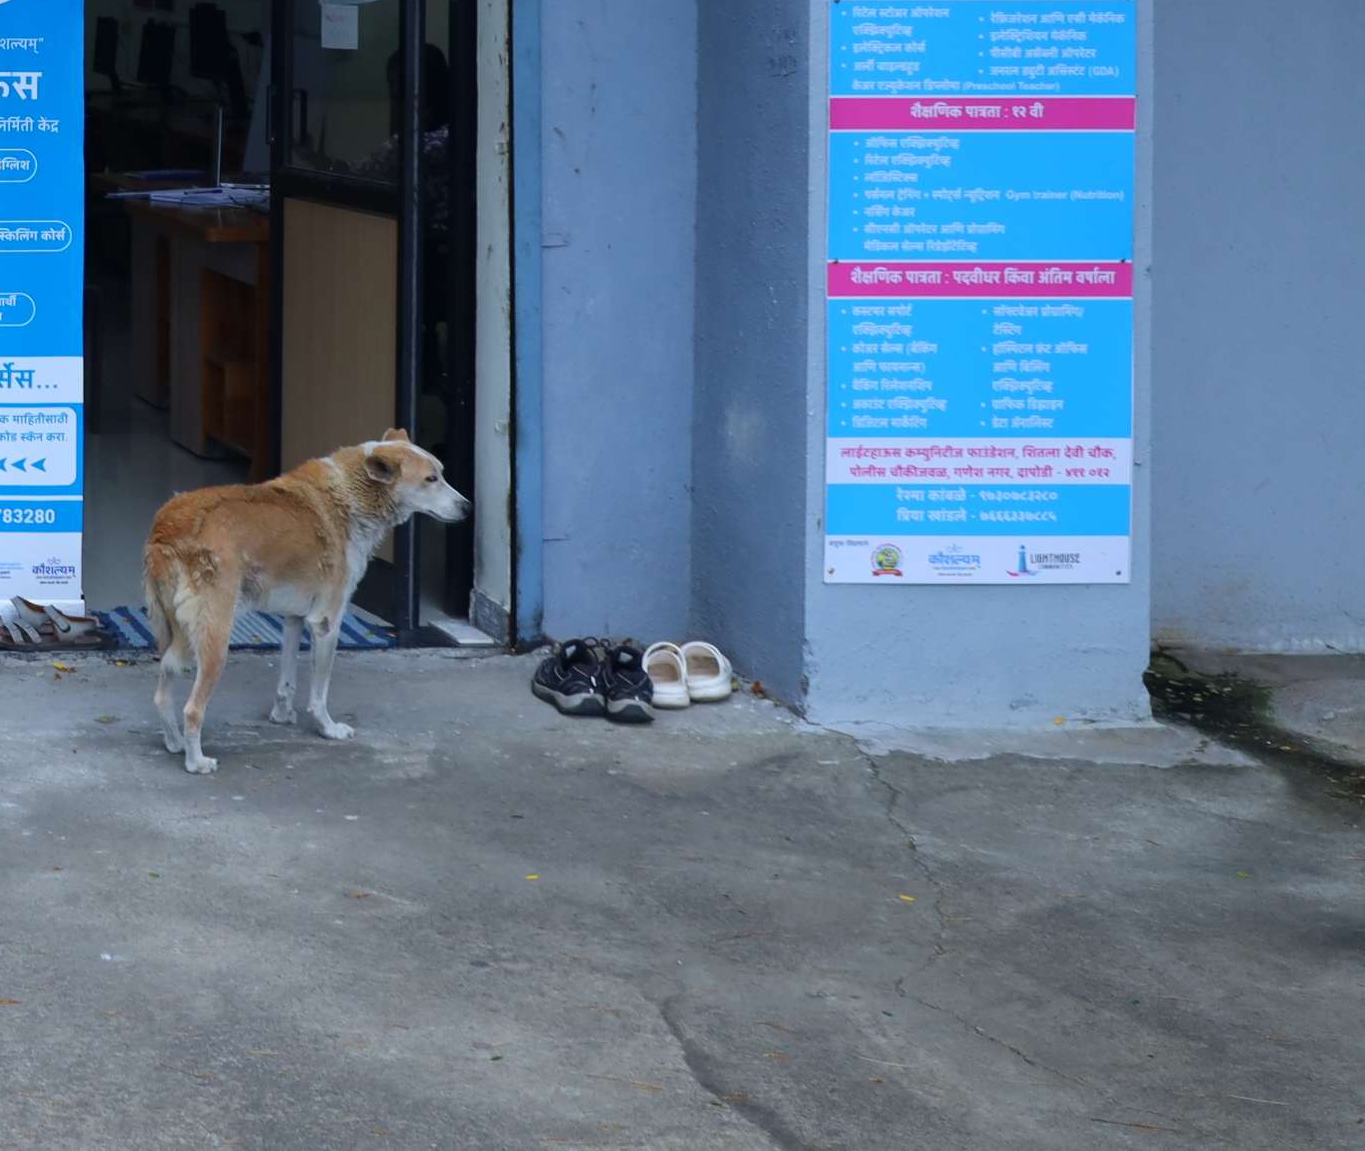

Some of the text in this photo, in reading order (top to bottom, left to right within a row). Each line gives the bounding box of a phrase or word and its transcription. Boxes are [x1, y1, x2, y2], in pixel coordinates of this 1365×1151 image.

[37, 117, 59, 132] केंद्र
[41, 226, 67, 240] कोर्स
[12, 412, 68, 425] माहितीसाठी
